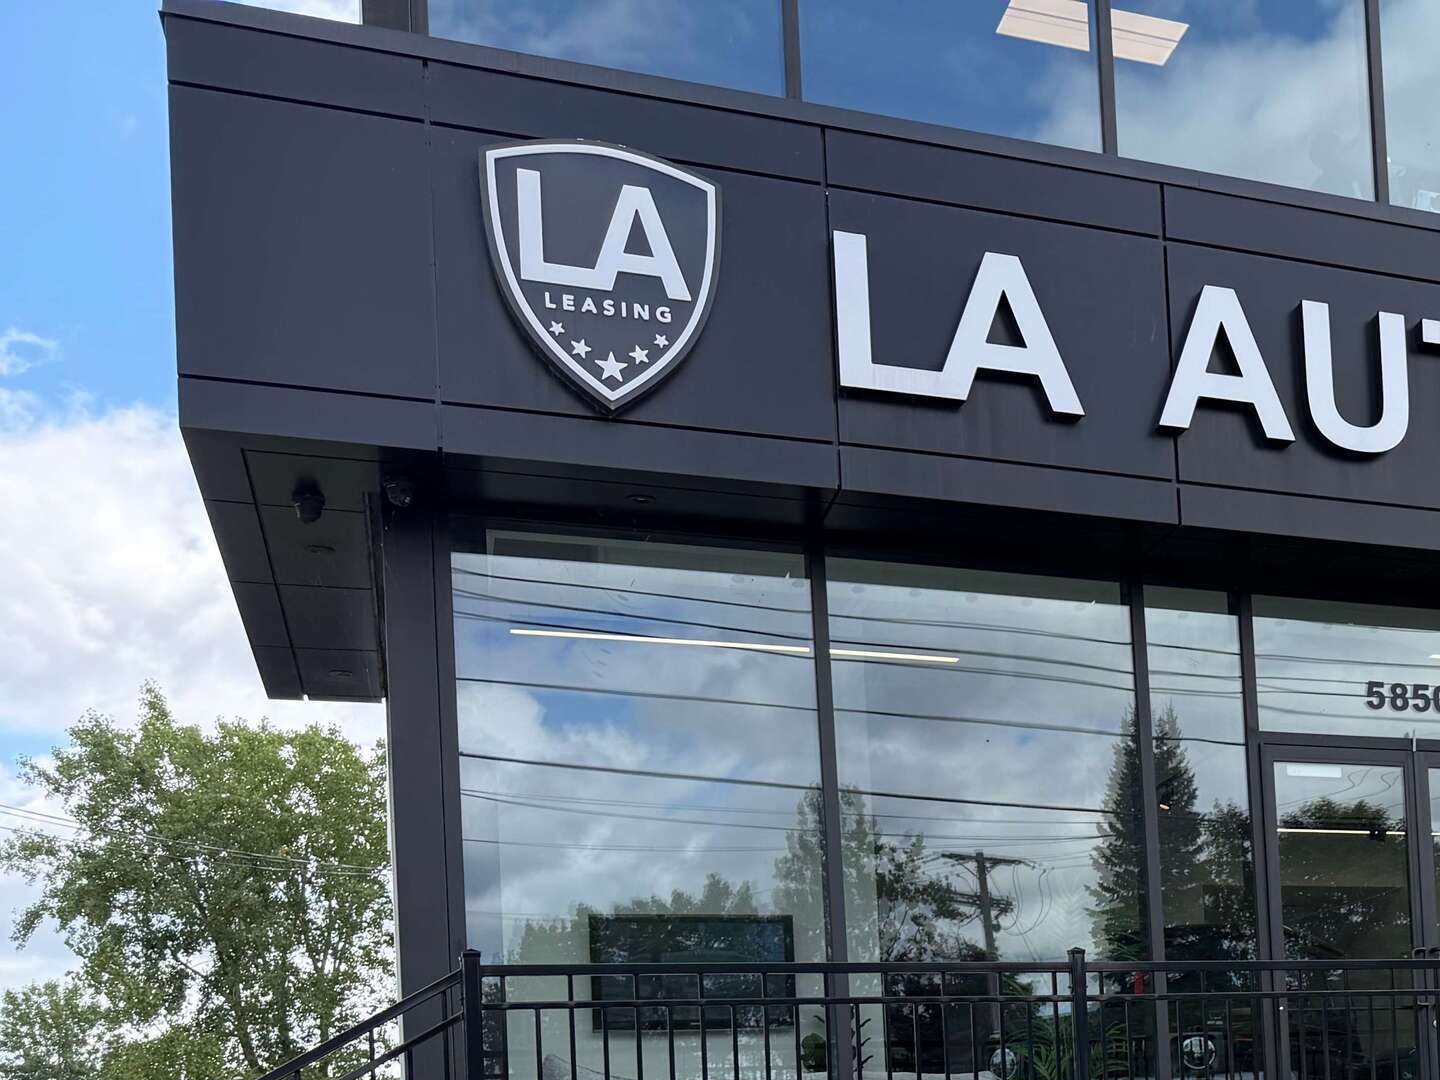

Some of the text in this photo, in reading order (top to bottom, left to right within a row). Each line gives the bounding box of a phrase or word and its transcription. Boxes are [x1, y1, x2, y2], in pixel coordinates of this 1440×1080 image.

[516, 168, 692, 302] LA
[544, 291, 673, 324] LEASING
[832, 230, 1086, 418] LA
